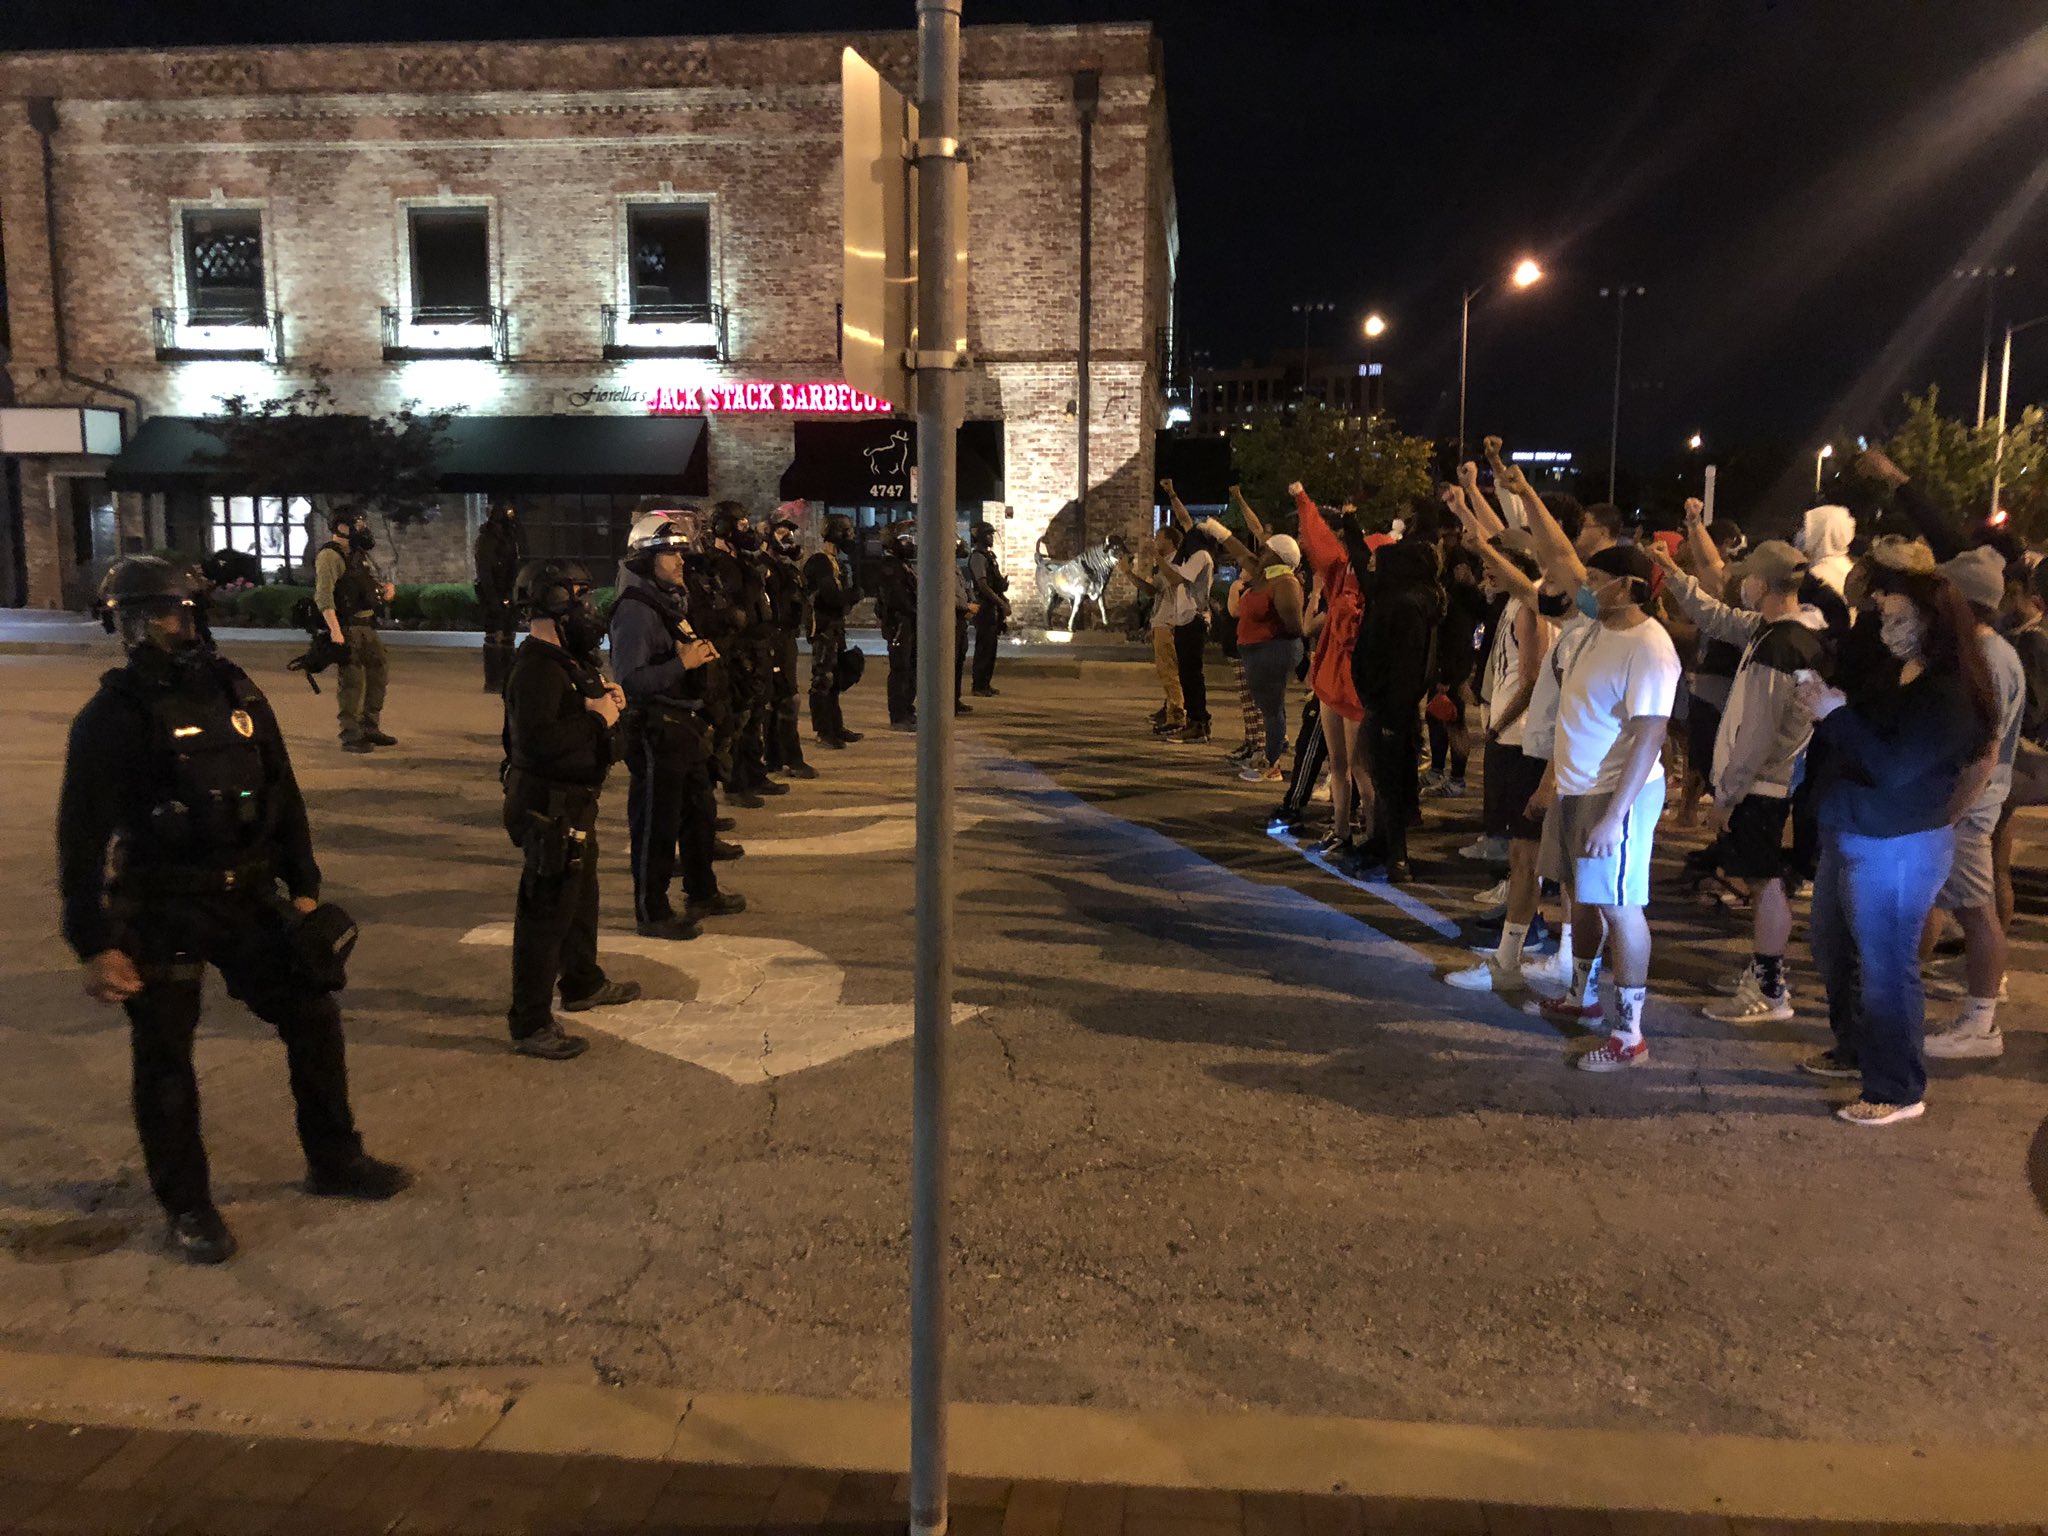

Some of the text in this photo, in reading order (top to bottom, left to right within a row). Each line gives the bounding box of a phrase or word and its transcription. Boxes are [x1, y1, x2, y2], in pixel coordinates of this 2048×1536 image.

[646, 384, 702, 411] JACK
[706, 383, 775, 411] STACK
[869, 484, 904, 497] 4747
